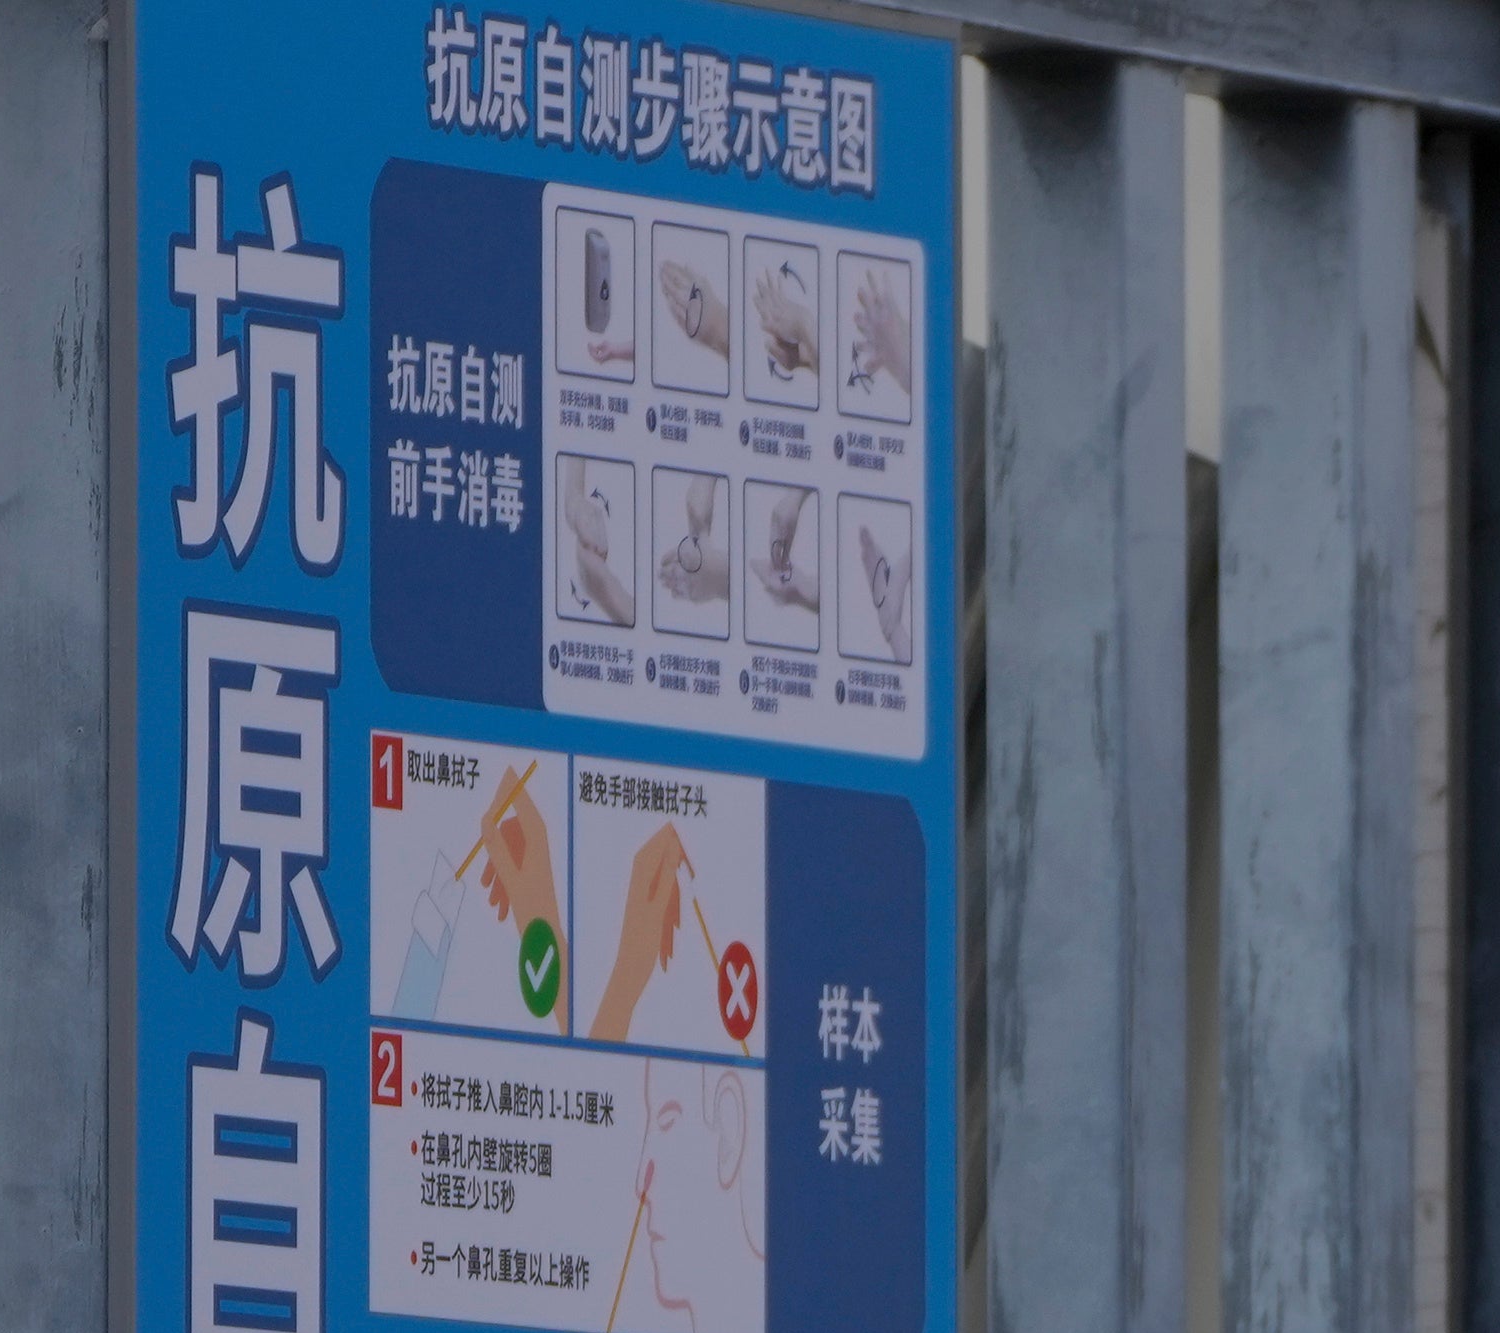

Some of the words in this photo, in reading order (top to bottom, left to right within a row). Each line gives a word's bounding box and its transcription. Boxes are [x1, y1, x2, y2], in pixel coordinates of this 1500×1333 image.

[427, 7, 876, 192] 抗原自测步骤示意图
[388, 337, 524, 430] 抗原自测
[388, 441, 524, 534] 前手消毒
[379, 744, 394, 801] 1
[407, 749, 481, 791] 取出鼻拭子
[579, 771, 708, 818] 避免手部接触拭子头
[817, 983, 882, 1065] 样本
[377, 1041, 396, 1099] 2
[421, 1072, 544, 1121] 将拭子推入鼻腔内
[548, 1090, 615, 1128] 1-1.5厘米
[817, 1087, 883, 1167] 采集
[421, 1132, 553, 1178] 在鼻孔内壁旋转5圈
[420, 1172, 516, 1214] 过程至少15秒
[421, 1241, 590, 1292] 另一个鼻孔重复以上操作
